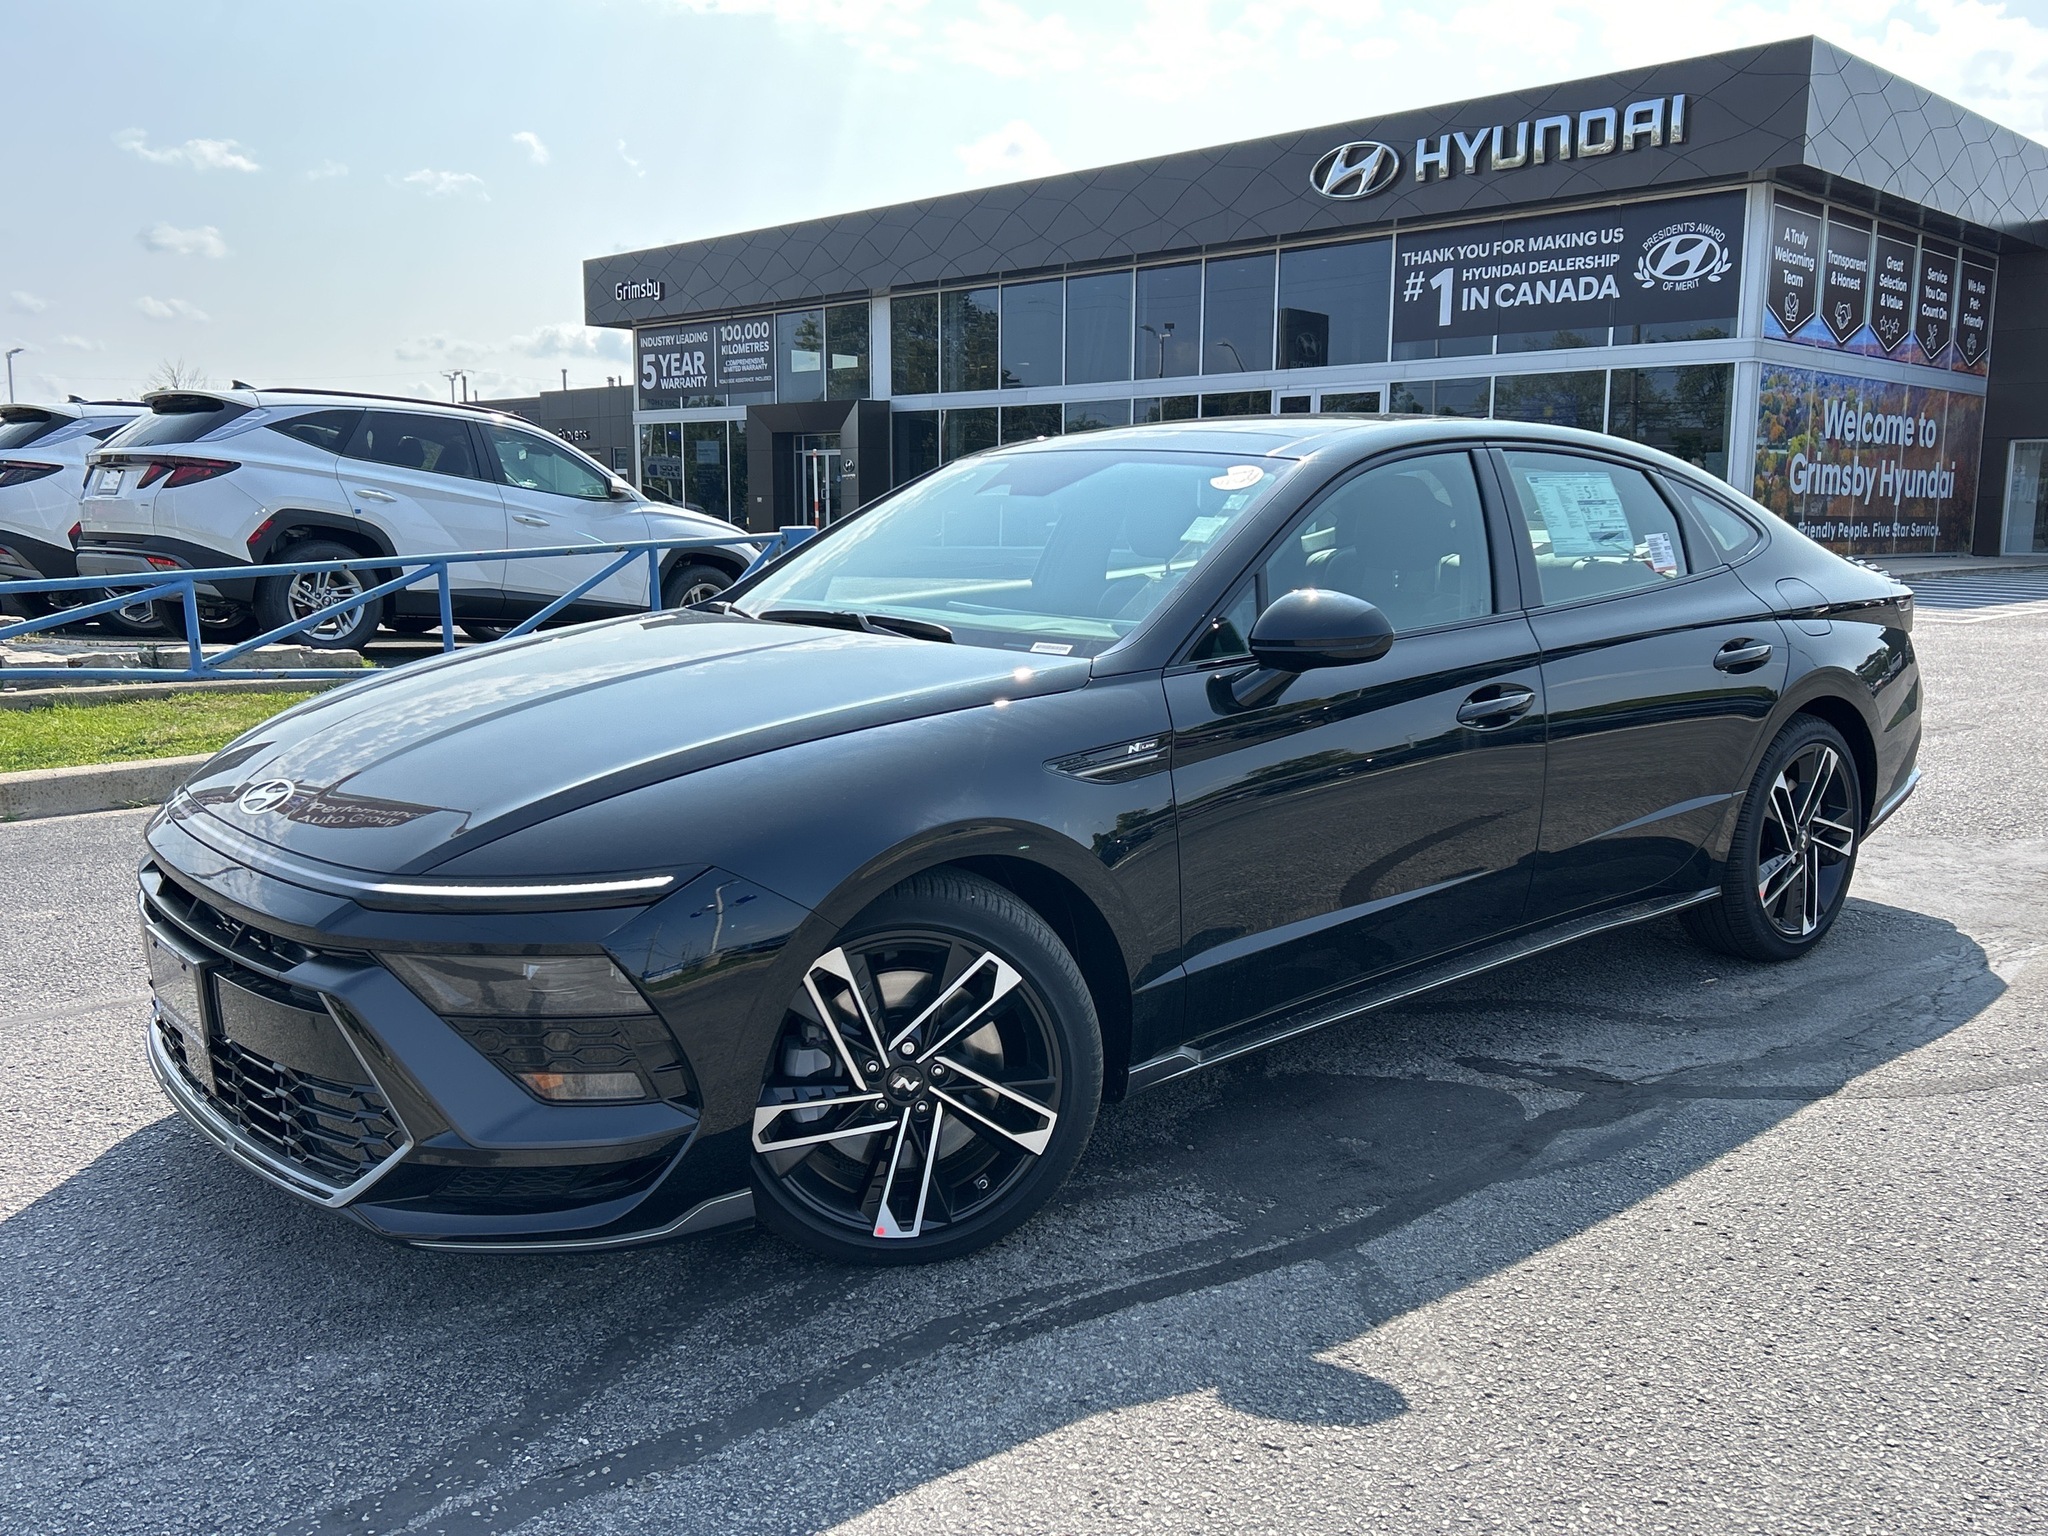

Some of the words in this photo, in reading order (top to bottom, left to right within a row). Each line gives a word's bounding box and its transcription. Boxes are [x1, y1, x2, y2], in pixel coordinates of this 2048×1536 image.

[1415, 94, 1685, 182] HYUNDAI
[1696, 223, 1725, 242] AWARD
[1783, 227, 1790, 241] A
[1791, 228, 1809, 249] Truly
[1402, 247, 1454, 266] THANK
[1457, 242, 1490, 259] YOU
[1493, 238, 1525, 256] FOR
[1528, 230, 1597, 251] MAKING
[1600, 227, 1624, 244] US
[1462, 262, 1526, 281] HYUNDAI
[1528, 253, 1620, 274] DEALERSHIP
[1774, 245, 1815, 272] Welcoming
[1827, 249, 1867, 272] Transparent
[1886, 256, 1904, 272] Great
[1662, 281, 1674, 291] OF
[1675, 278, 1699, 291] MERIT
[1783, 269, 1803, 287] Team
[1830, 271, 1836, 285] &
[1837, 272, 1861, 290] Honest
[1879, 273, 1907, 292] Selection
[1927, 267, 1948, 284] Service
[615, 278, 660, 301] Grimsby
[1462, 286, 1490, 311] IN
[1495, 274, 1620, 308] CANADA
[1925, 285, 1936, 300] You
[1936, 288, 1948, 302] Can
[1967, 279, 1977, 292] We
[1977, 281, 1986, 294] Are
[1880, 293, 1886, 306] &
[1886, 294, 1904, 310] Value
[1921, 303, 1939, 318] Count
[1939, 307, 1948, 320] On
[1963, 313, 1984, 330] Friendly
[640, 335, 674, 348] INDUSTRY
[675, 332, 708, 344] LEADING
[720, 321, 770, 343] 100,000
[721, 341, 770, 355] KILOMETRES
[641, 353, 657, 390] 5
[658, 351, 706, 377] YEAR
[660, 376, 708, 390] WARRANTY
[1824, 399, 1915, 447] Welcome
[1919, 412, 1937, 448] to
[1789, 451, 1877, 505] Grimsby
[1879, 459, 1956, 505] Hyundai
[1798, 521, 1836, 541] Friendly
[1838, 522, 1870, 540] People.
[1872, 521, 1890, 538] Five
[1892, 522, 1909, 538] Star
[297, 814, 345, 824] Auto
[348, 813, 401, 827] Group
